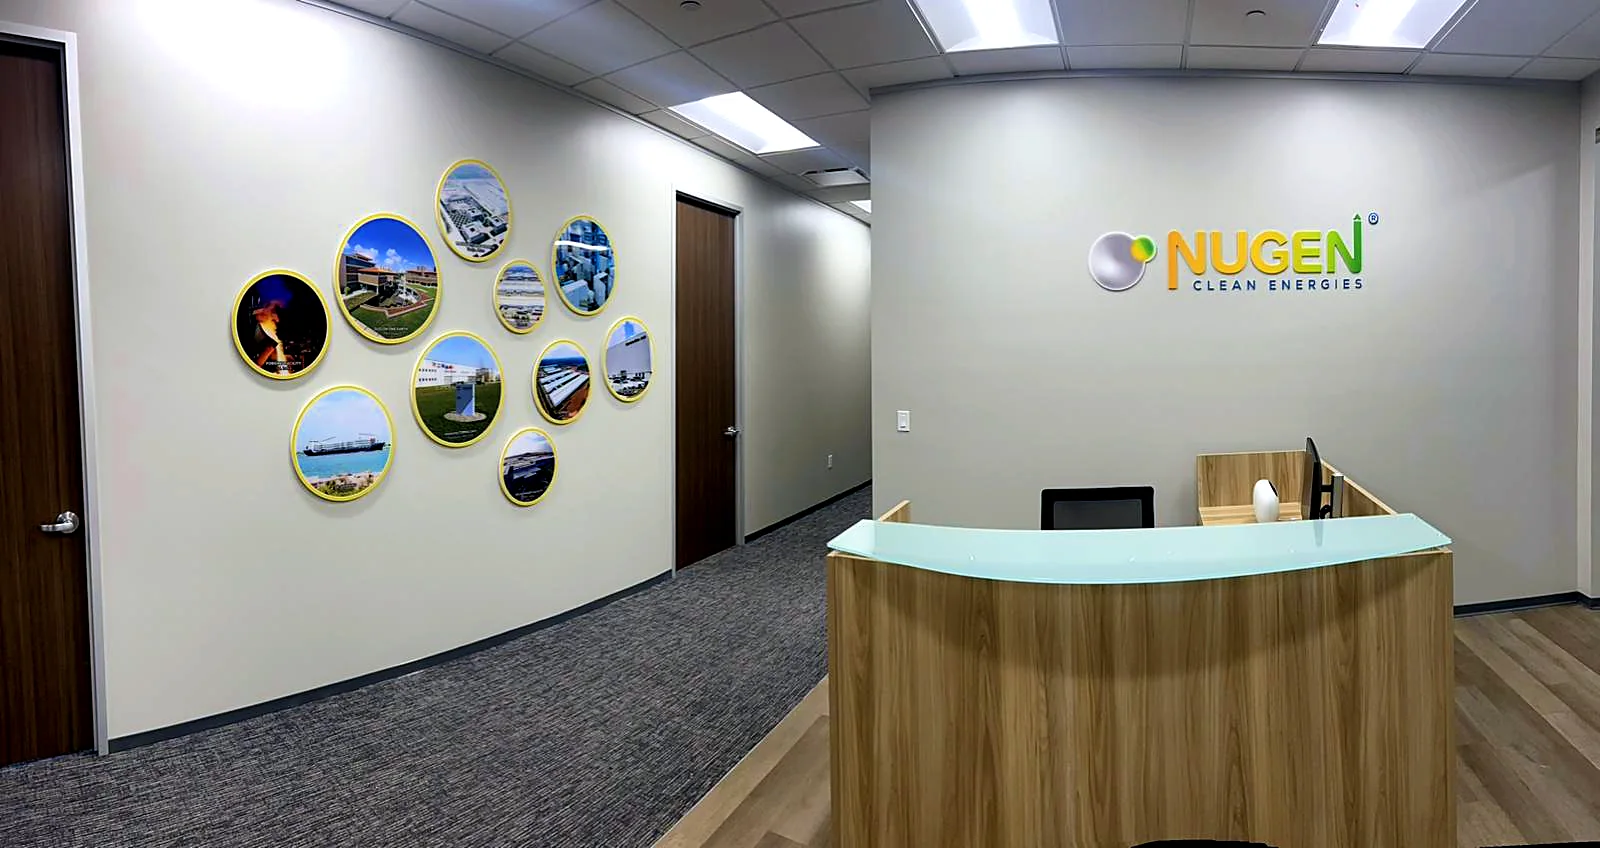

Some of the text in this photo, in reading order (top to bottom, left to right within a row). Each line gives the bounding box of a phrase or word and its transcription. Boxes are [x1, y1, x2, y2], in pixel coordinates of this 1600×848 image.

[1168, 214, 1362, 290] NUGEN
[1193, 279, 1362, 291] CLEAN ENERGIES
